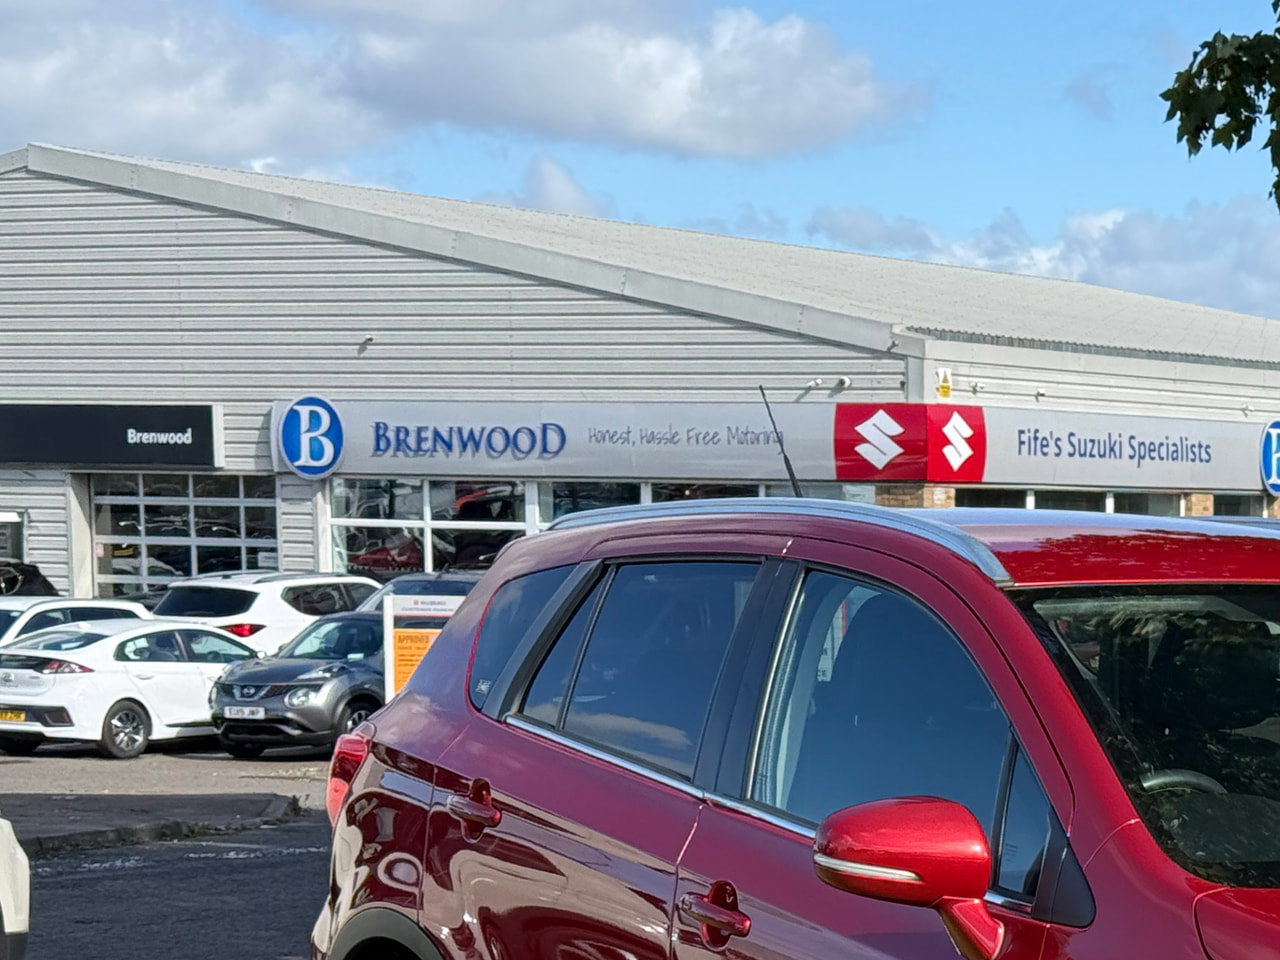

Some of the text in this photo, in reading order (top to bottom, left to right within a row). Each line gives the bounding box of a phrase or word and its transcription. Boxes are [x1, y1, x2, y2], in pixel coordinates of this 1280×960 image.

[126, 427, 192, 444] Brenwood
[371, 421, 567, 458] BRENWOOD
[588, 426, 636, 447] Honest,
[639, 424, 681, 446] Hassle
[686, 427, 721, 446] Free
[1017, 428, 1212, 468] Fife's Suzuki Specialists
